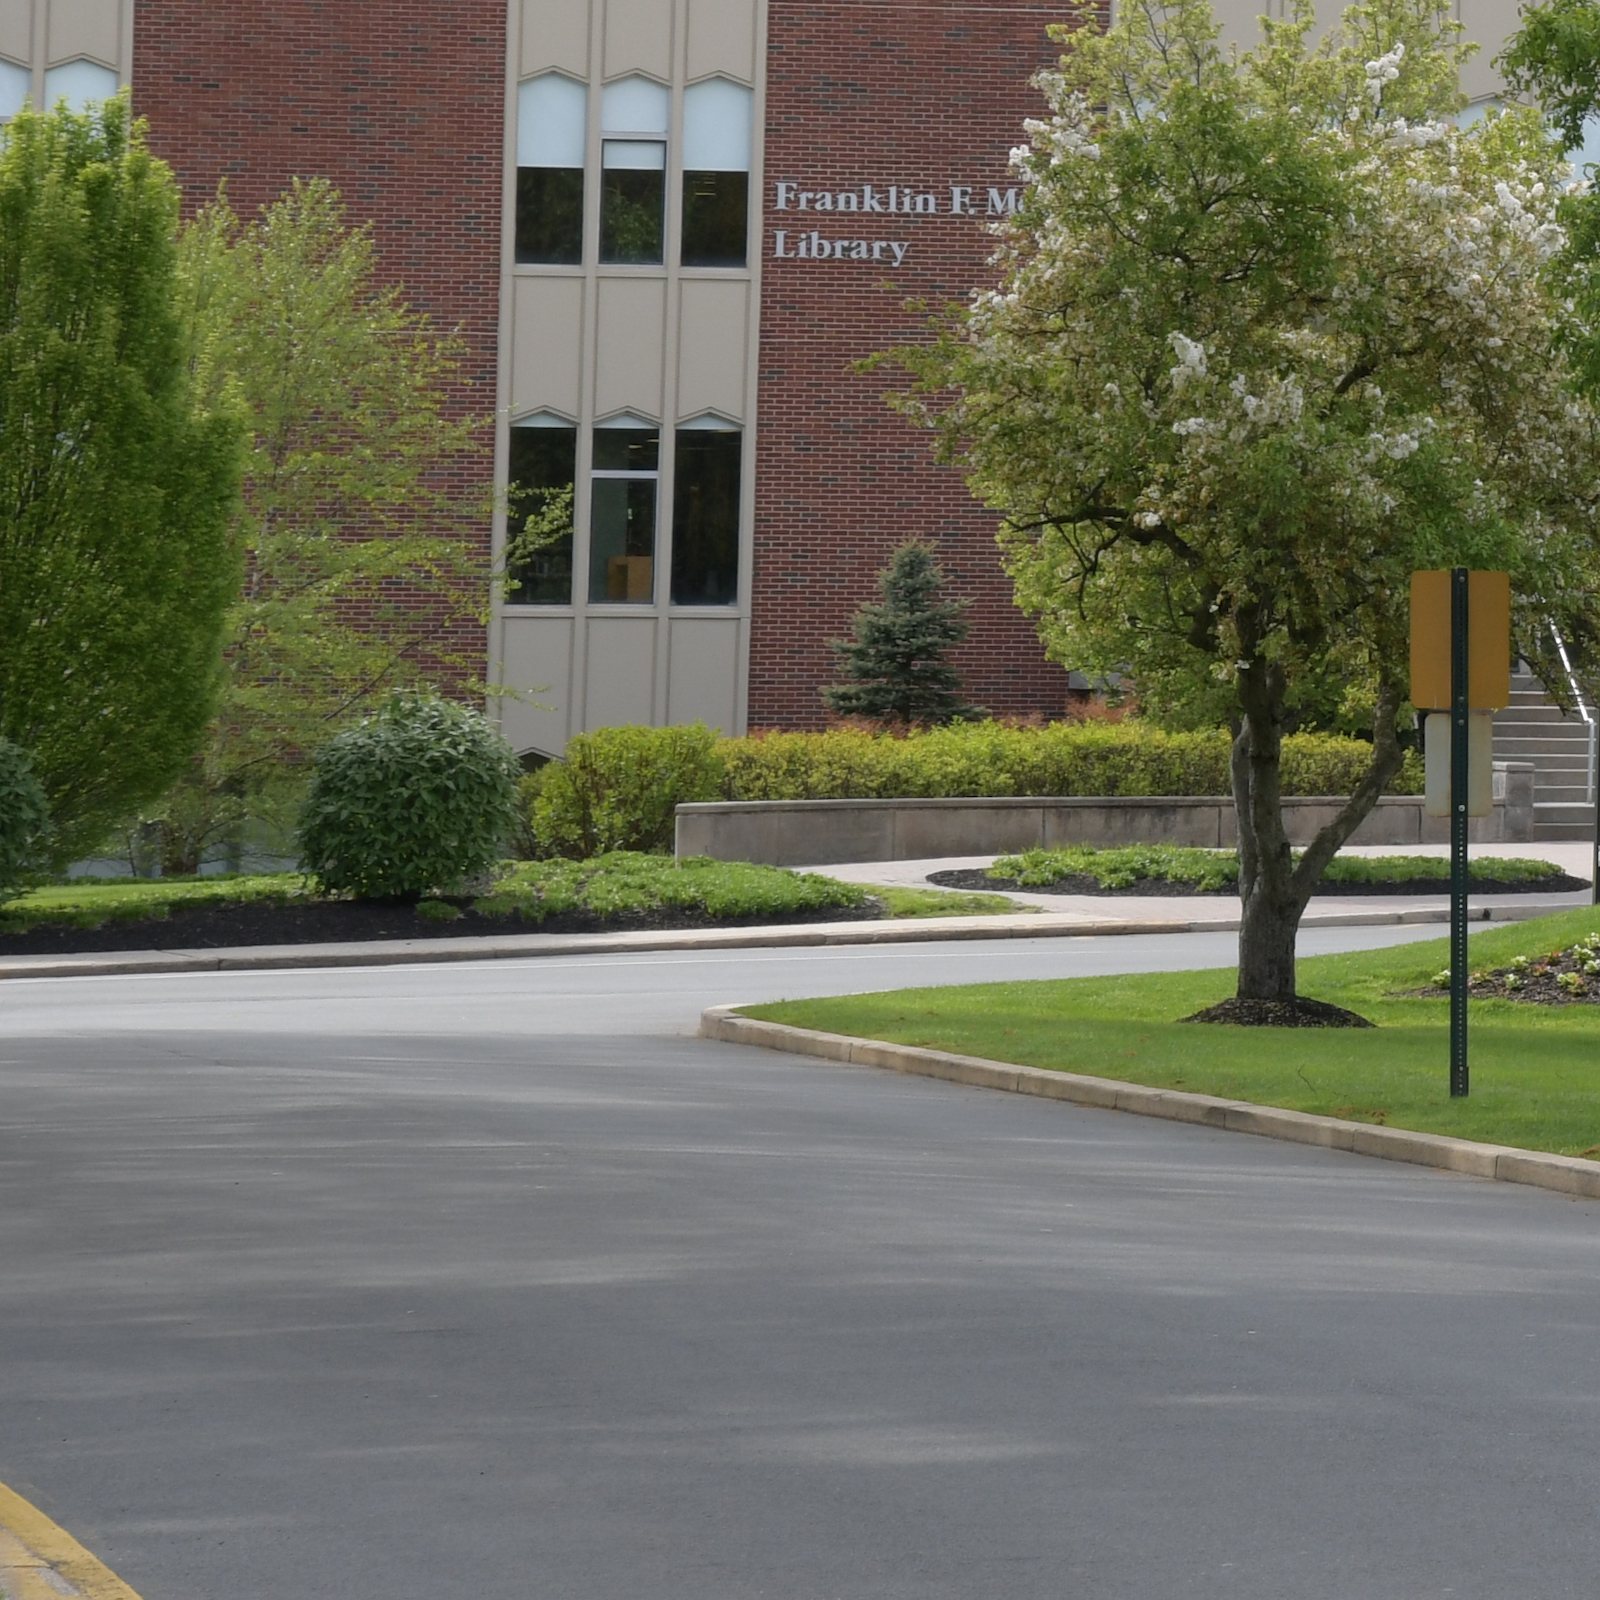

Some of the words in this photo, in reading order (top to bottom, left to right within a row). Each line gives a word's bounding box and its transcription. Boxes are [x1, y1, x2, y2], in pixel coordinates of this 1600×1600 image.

[774, 182, 938, 214] Franklin
[949, 186, 976, 215] F.
[772, 230, 910, 267] Library
